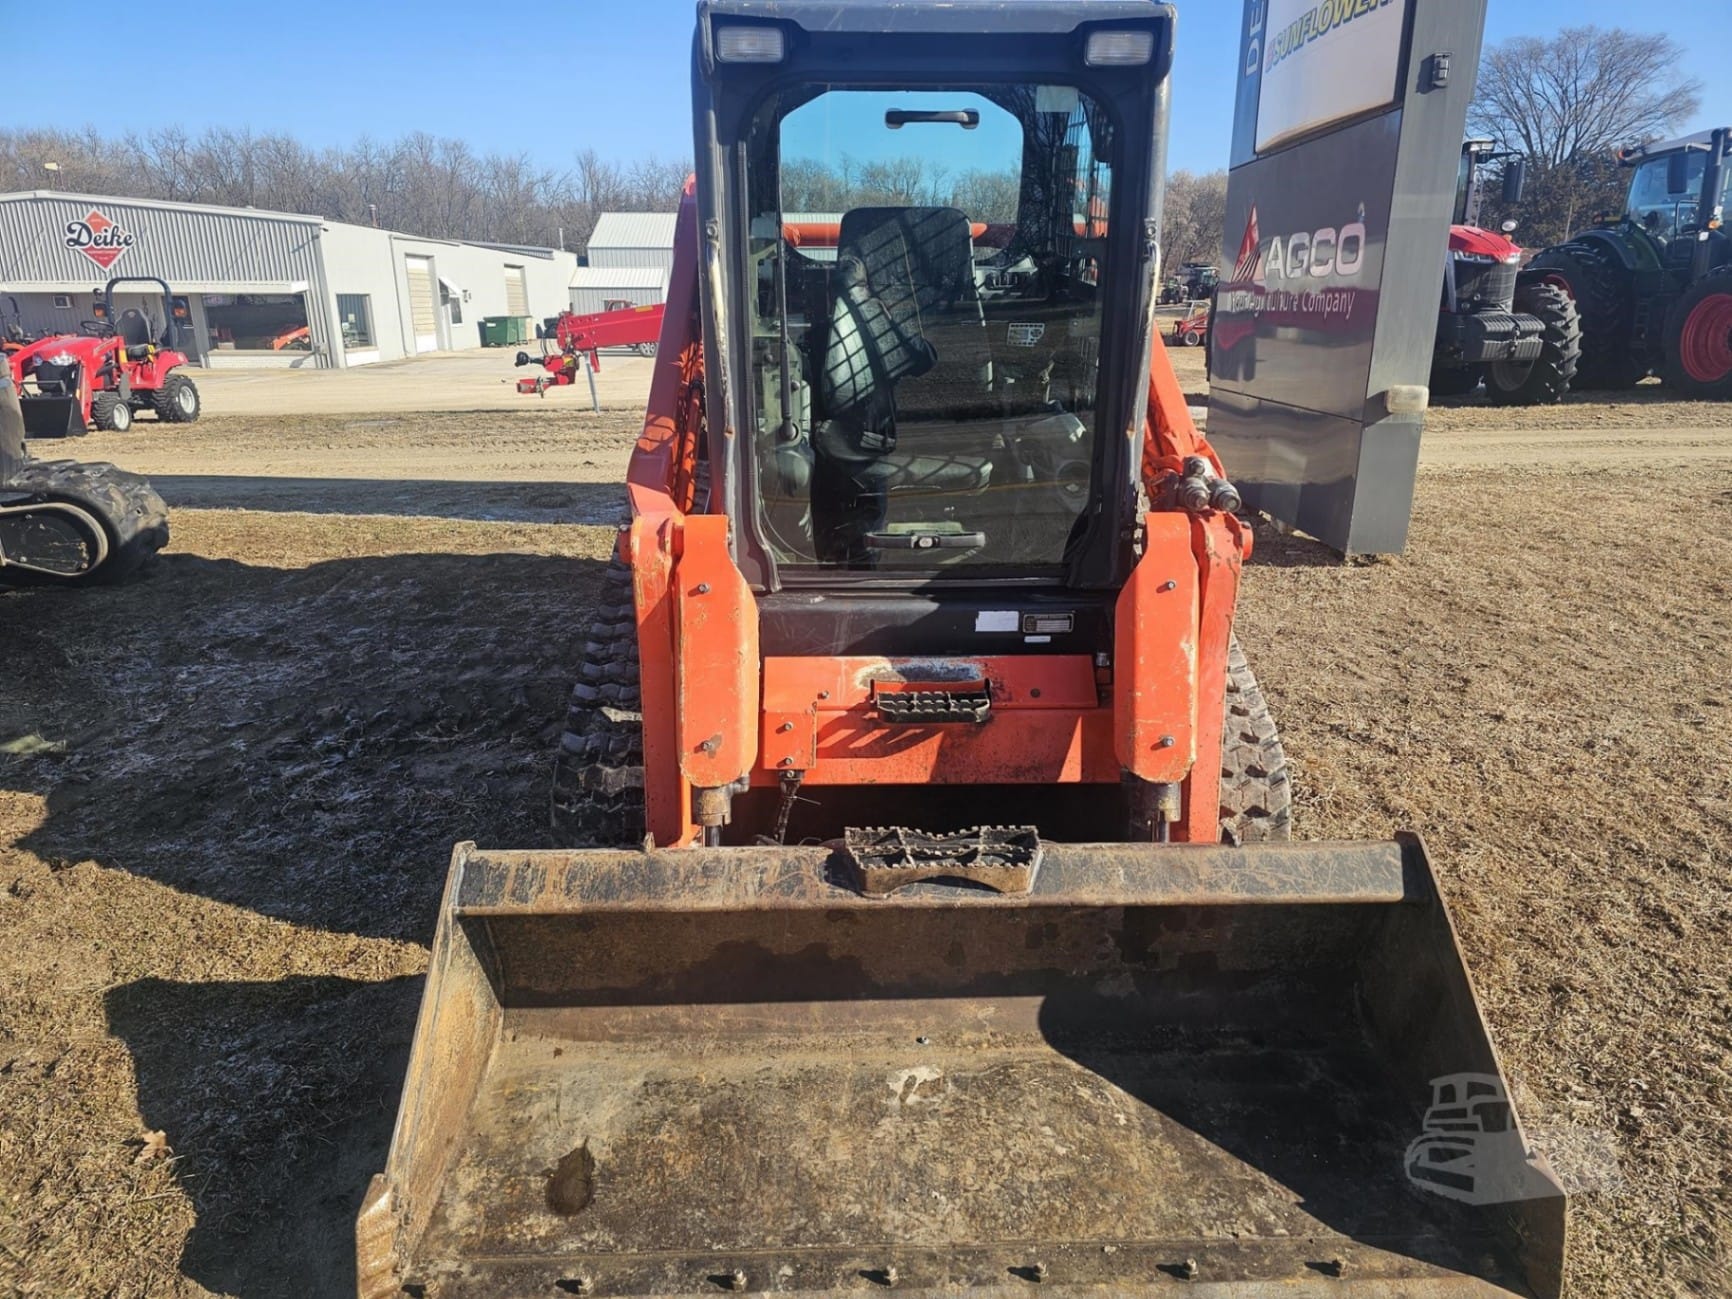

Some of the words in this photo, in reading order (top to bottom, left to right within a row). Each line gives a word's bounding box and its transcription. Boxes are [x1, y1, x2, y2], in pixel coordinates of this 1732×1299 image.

[1246, 0, 1264, 76] DE
[65, 221, 134, 247] Deike
[1264, 222, 1365, 279] AGCO
[1302, 288, 1355, 319] Company
